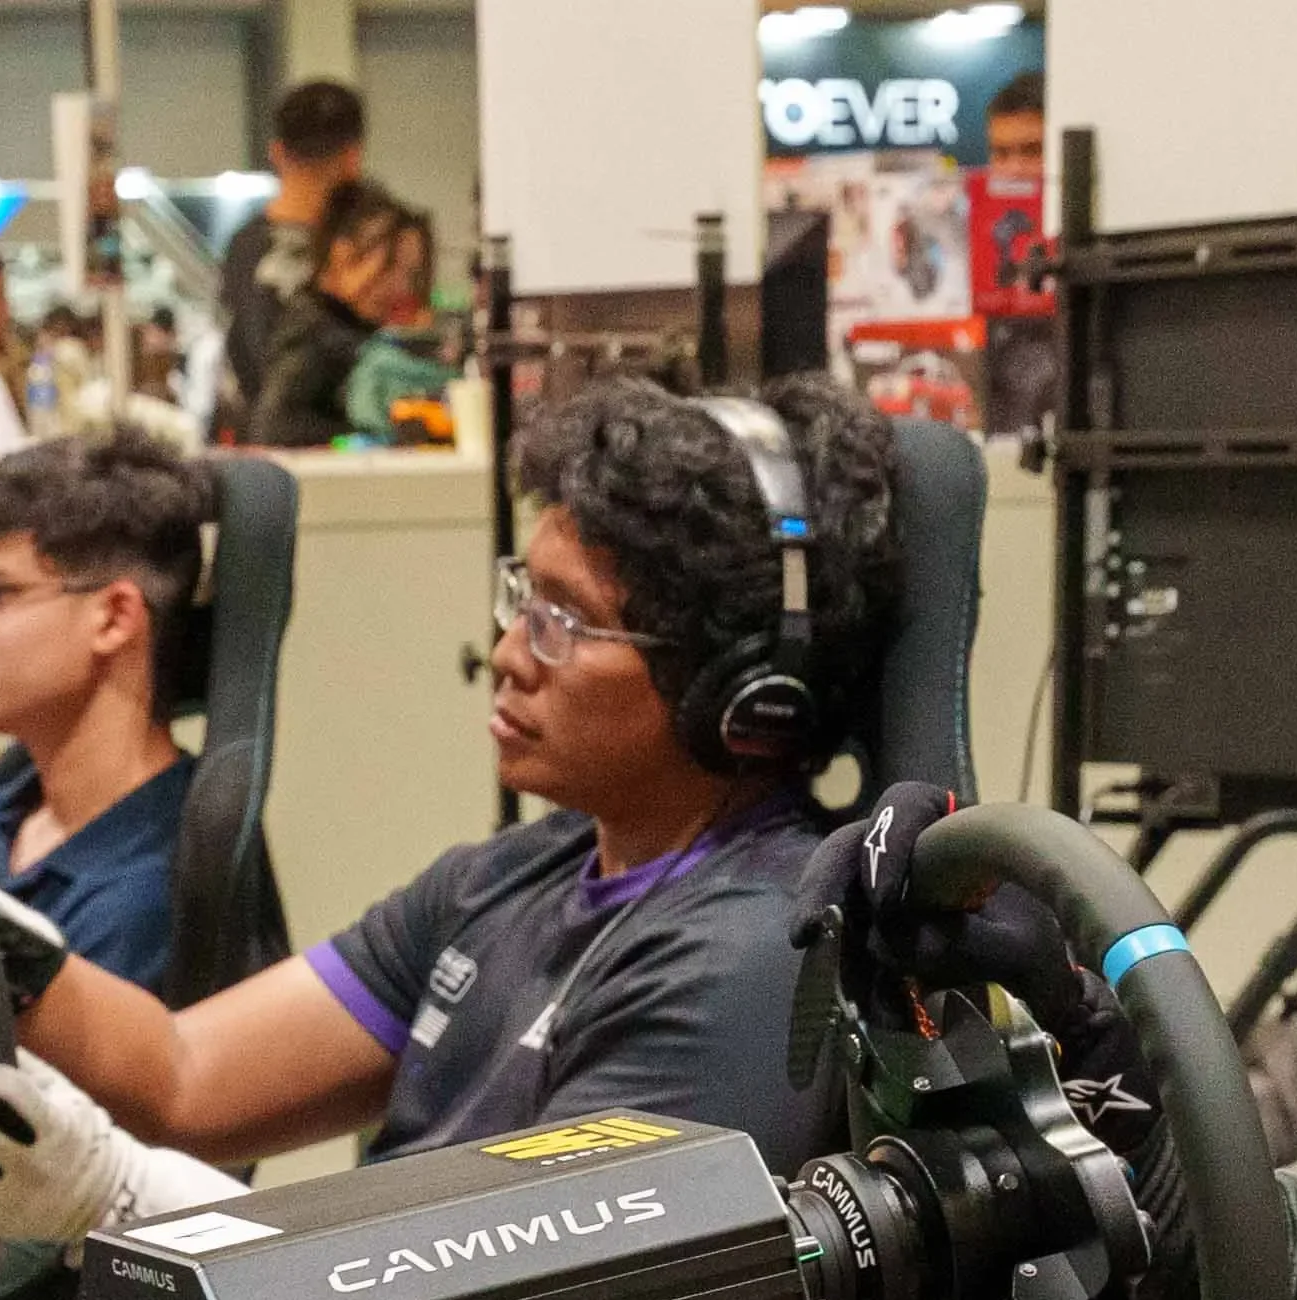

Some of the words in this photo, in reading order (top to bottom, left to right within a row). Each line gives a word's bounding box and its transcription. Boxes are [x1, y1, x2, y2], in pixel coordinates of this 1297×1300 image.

[758, 77, 959, 146] OEVER
[326, 1187, 667, 1293] CAMMUS
[812, 1165, 877, 1270] CAMMUS
[110, 1257, 177, 1293] CAMMUS
